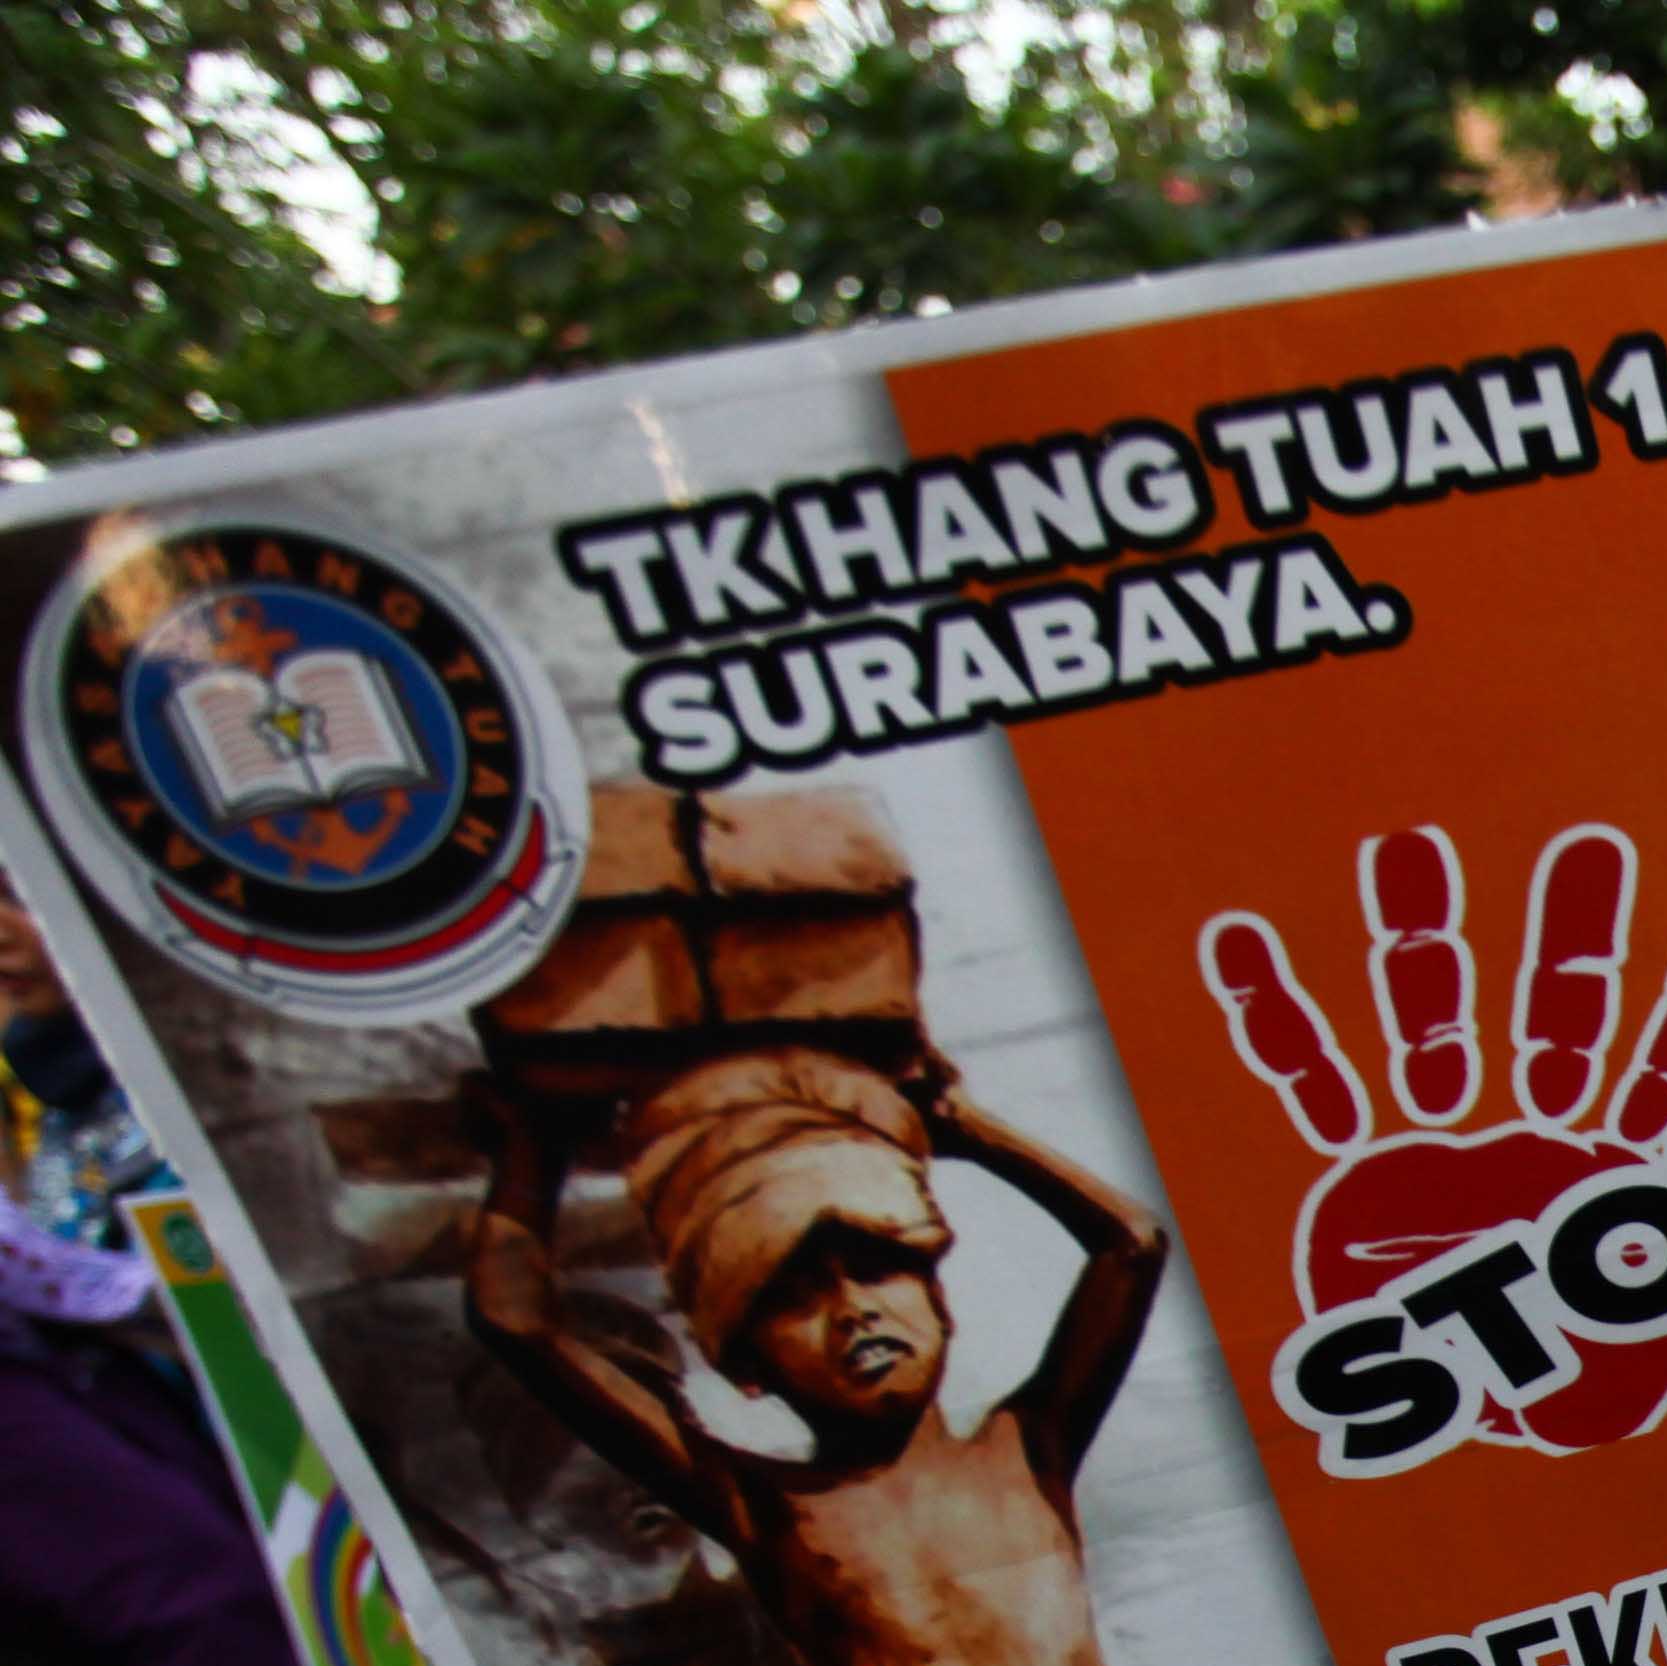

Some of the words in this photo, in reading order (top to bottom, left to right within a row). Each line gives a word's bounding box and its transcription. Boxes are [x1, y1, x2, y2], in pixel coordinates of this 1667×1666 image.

[575, 514, 785, 640] TK
[796, 444, 1203, 592] HANG
[1212, 363, 1586, 518] TUAH
[442, 649, 511, 858] TUAH
[636, 548, 1403, 776] SURABAYA.
